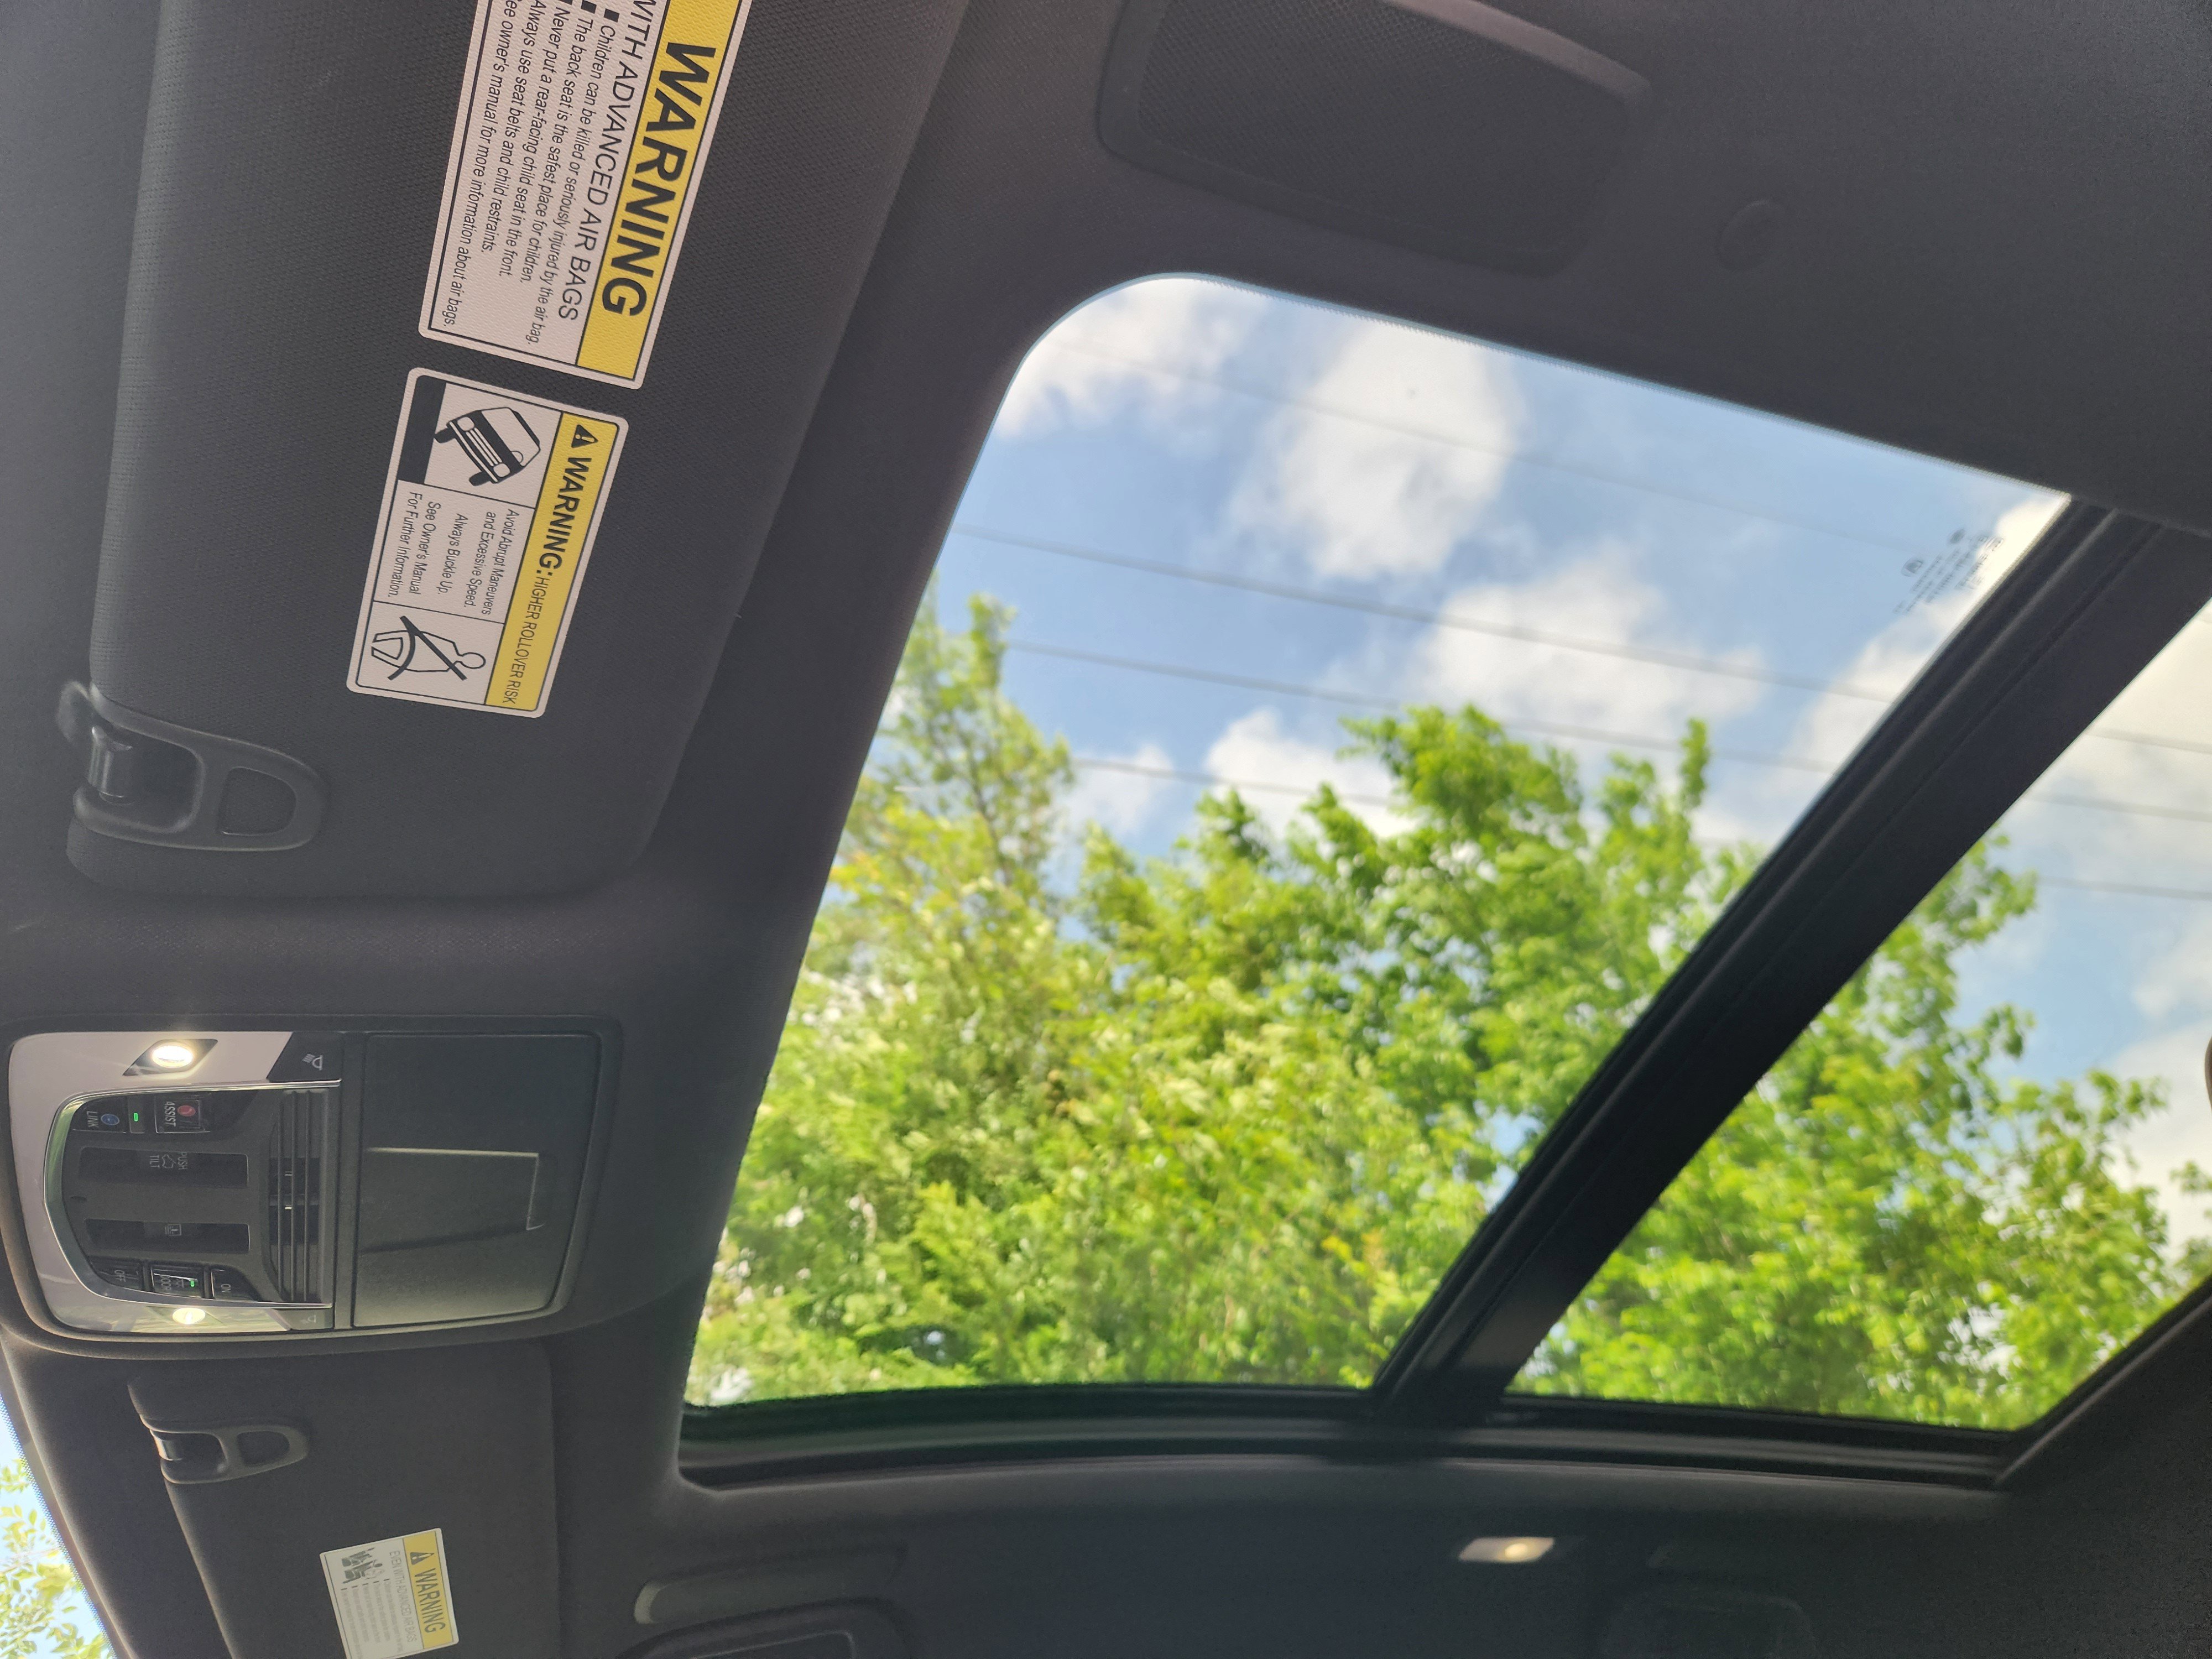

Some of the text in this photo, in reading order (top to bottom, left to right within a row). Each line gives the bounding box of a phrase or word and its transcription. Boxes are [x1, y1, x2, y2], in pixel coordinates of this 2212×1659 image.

[442, 0, 521, 327] ee owner's manual for more information about air bags.
[481, 0, 547, 253] Always use seat belts and child restraints.
[498, 6, 571, 276] Never put a rear-facing child seat in the front.
[519, 18, 594, 283] The back seat is the safest place for children.
[587, 60, 638, 206] ADVANCED
[525, 25, 616, 345] Children can be killed or seriously injured by the air bag.
[602, 42, 717, 316] WARNING
[574, 207, 602, 251] AIR
[558, 255, 592, 321] BAGS
[388, 491, 423, 597] For Further Information.
[409, 501, 442, 595] See Owner's Manual
[437, 513, 469, 594] Always Buckle Up.
[463, 512, 496, 607] and Excessive Speed.
[481, 508, 520, 615] Avoid Abrupt Maneuvers
[503, 457, 592, 705] WARNING: HIGHER ROLLOVER RISK
[86, 1111, 99, 1128] LINK
[164, 1102, 176, 1126] ASSIST
[178, 1151, 189, 1170] PUSH
[149, 1155, 160, 1168] TILT
[114, 1270, 126, 1282] OFF
[221, 1283, 232, 1293] ON
[414, 1567, 446, 1634] WARNING
